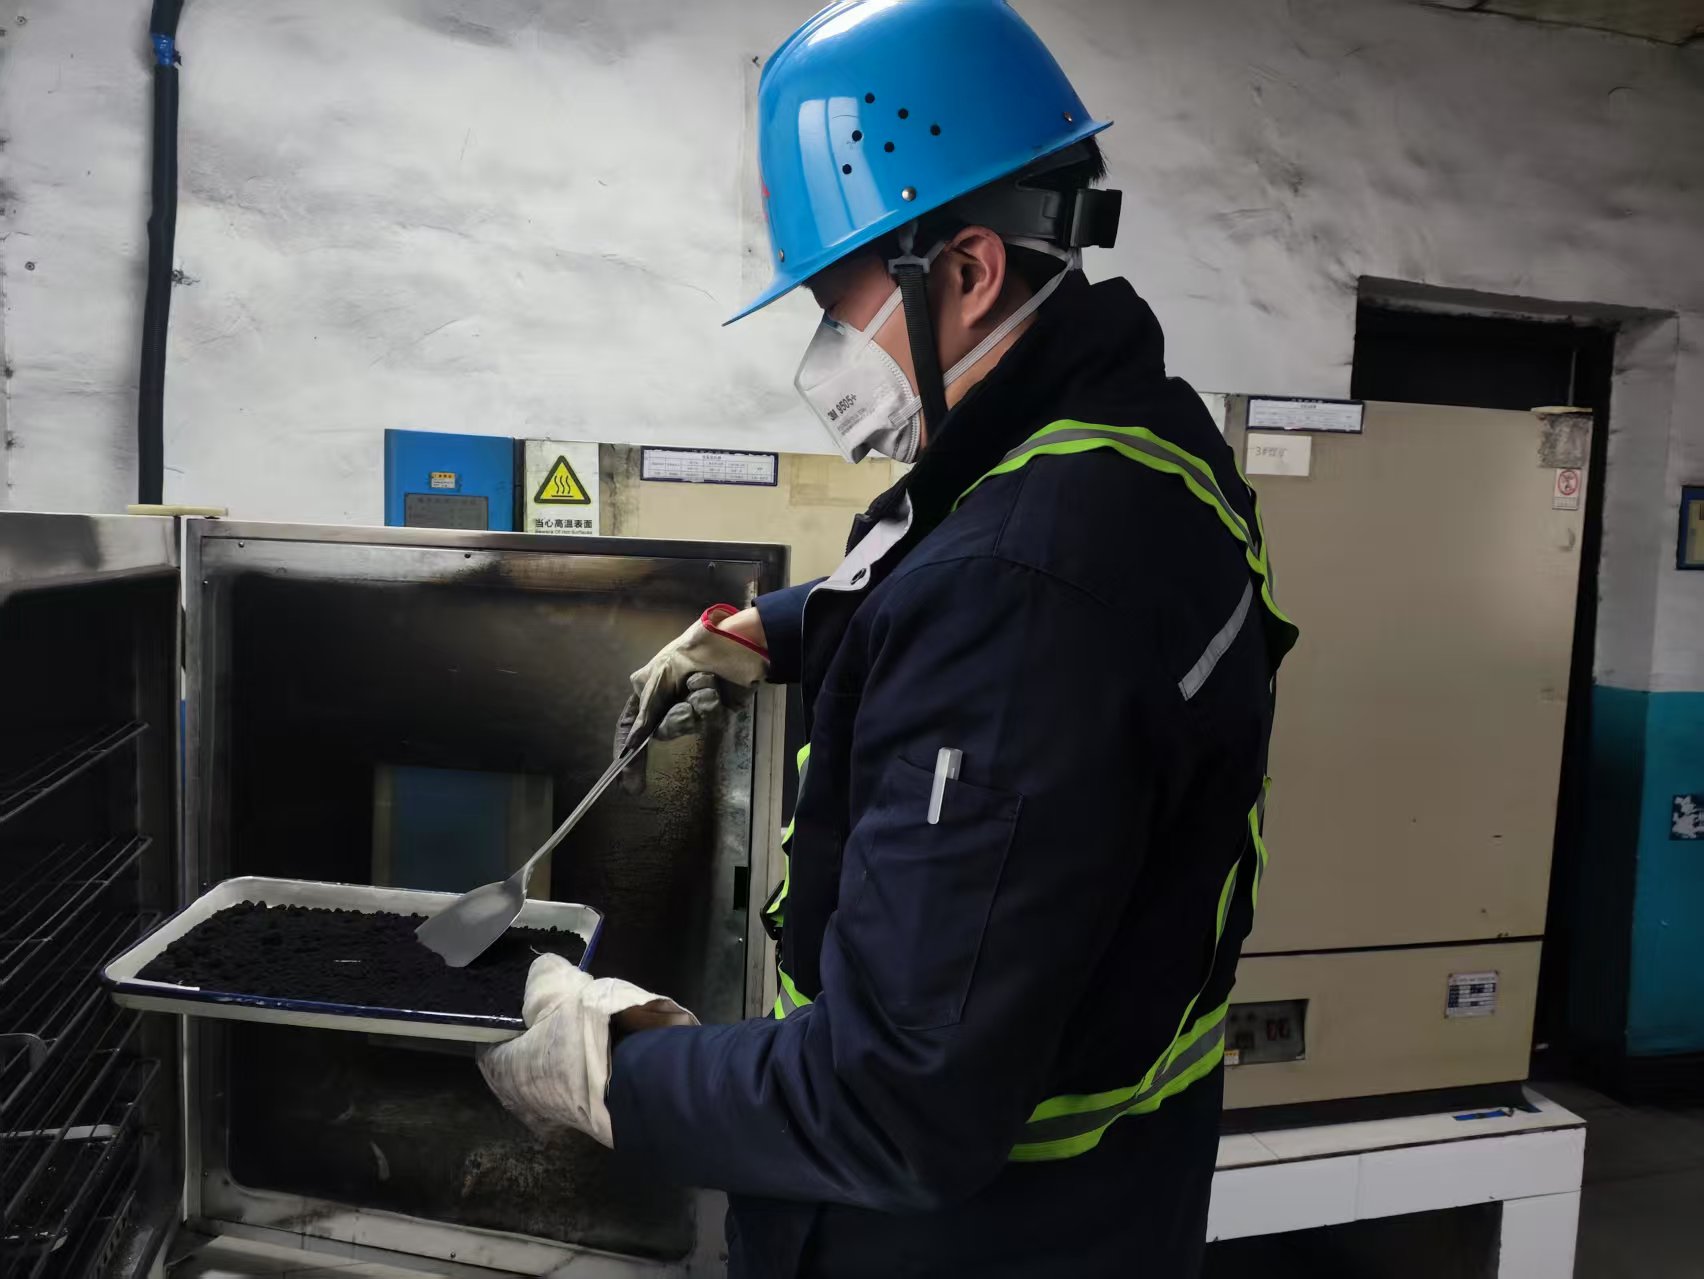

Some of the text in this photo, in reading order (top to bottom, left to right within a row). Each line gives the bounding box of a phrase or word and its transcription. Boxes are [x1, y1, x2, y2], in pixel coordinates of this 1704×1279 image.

[827, 408, 838, 421] 3M
[836, 394, 857, 414] 9505+
[535, 518, 592, 528] 当心高温表面
